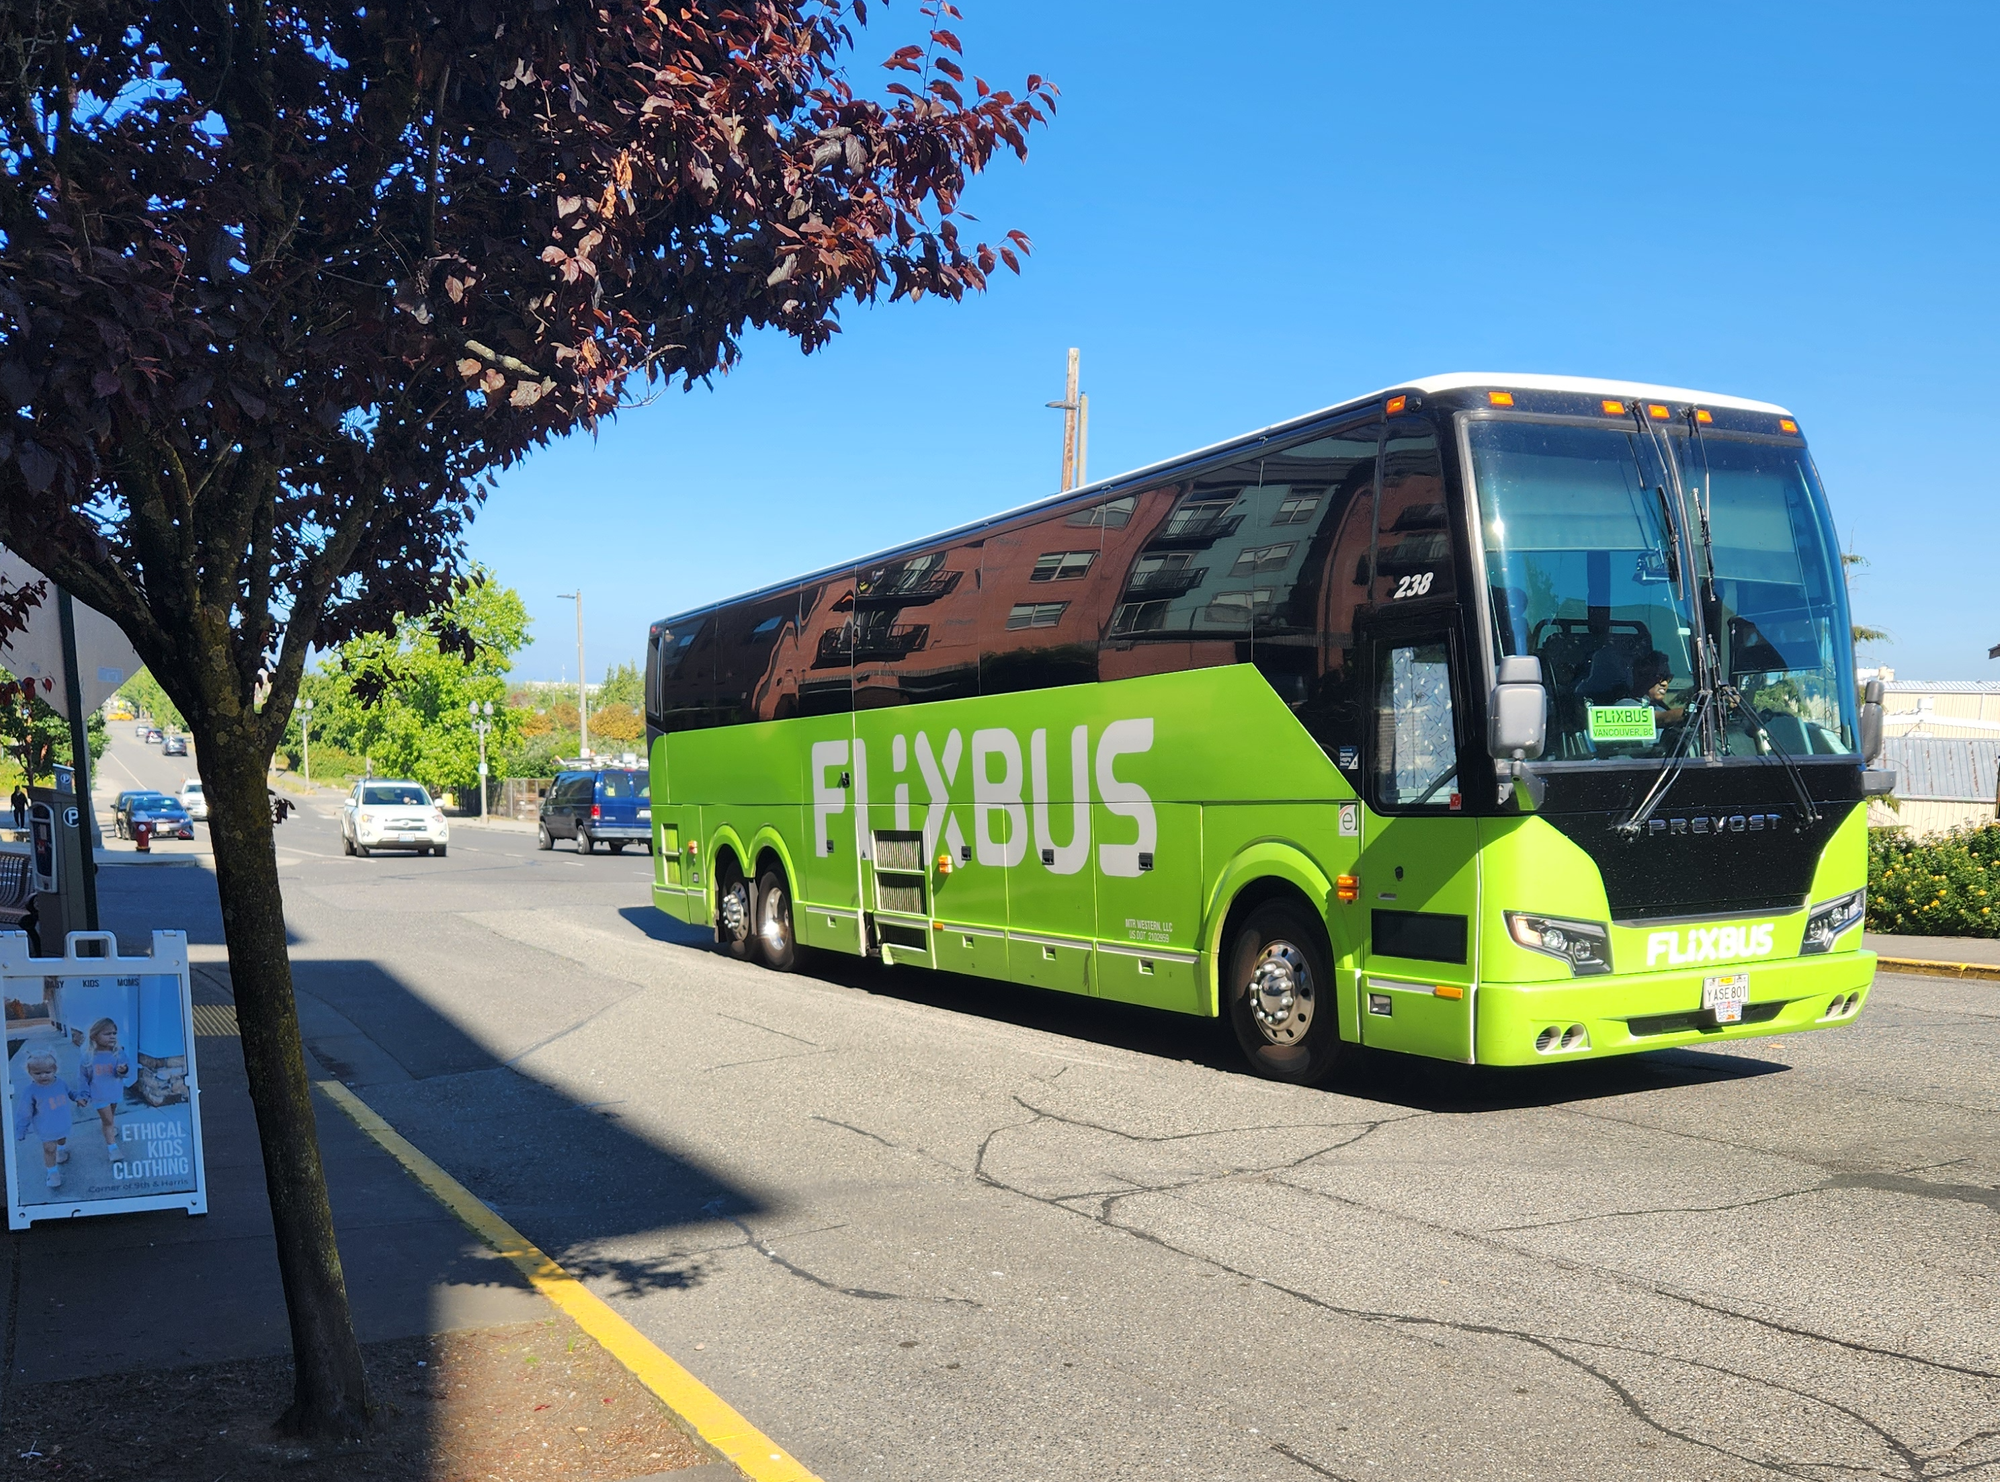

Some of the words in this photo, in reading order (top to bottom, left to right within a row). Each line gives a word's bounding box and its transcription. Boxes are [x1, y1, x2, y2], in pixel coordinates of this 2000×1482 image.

[1393, 572, 1434, 598] 238
[1593, 728, 1643, 737] VANCOUVER,
[1643, 728, 1654, 736] BC
[1648, 813, 1782, 836] PREVOST
[1162, 922, 1173, 932] LLC
[82, 979, 99, 988] KIDS
[117, 977, 140, 987] MOMS
[121, 1121, 186, 1141] ETHICAL
[147, 1139, 183, 1158] KIDS
[113, 1157, 189, 1180] CLOTHING
[88, 1184, 120, 1193] Corner
[122, 1181, 132, 1189] of
